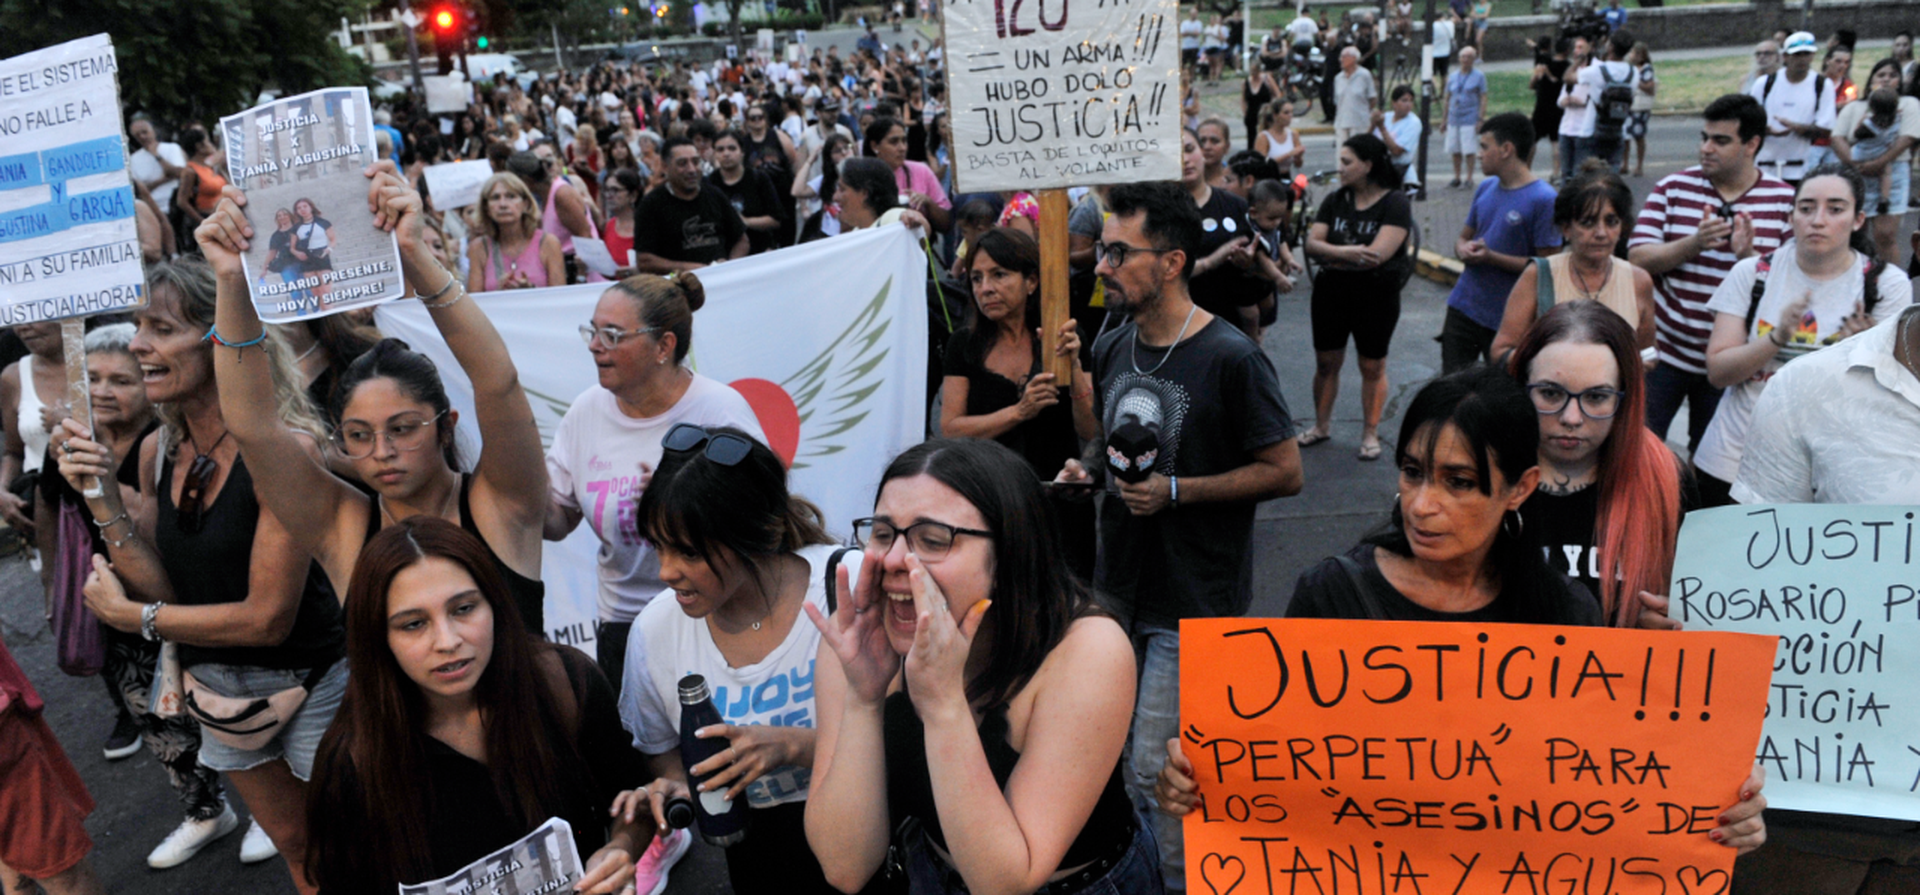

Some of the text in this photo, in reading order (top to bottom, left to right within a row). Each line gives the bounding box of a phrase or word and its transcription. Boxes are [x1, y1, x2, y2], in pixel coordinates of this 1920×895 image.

[1014, 49, 1050, 70] UN
[19, 73, 39, 93] EL
[43, 53, 117, 87] SISTEMA
[985, 68, 1132, 102] HUBO DOLO
[25, 102, 76, 131] FALLE
[81, 99, 92, 118] A
[262, 113, 320, 136] JUSTICIA
[240, 161, 279, 180] TANIA
[282, 158, 291, 169] Y
[967, 150, 1036, 170] BASTA
[1043, 147, 1070, 160] DE
[1019, 156, 1146, 180] AL VOLANTE
[52, 182, 62, 204] Y
[41, 256, 66, 275] SU
[76, 285, 137, 314] AHORA
[258, 276, 322, 297] ROSARIO
[276, 281, 385, 313] HOY Y SIEMPRE!
[1544, 737, 1671, 789] PARA
[1199, 792, 1288, 823] LOS
[1647, 801, 1721, 836] DE
[1449, 851, 1482, 895] Y
[1498, 850, 1667, 895] AGUS
